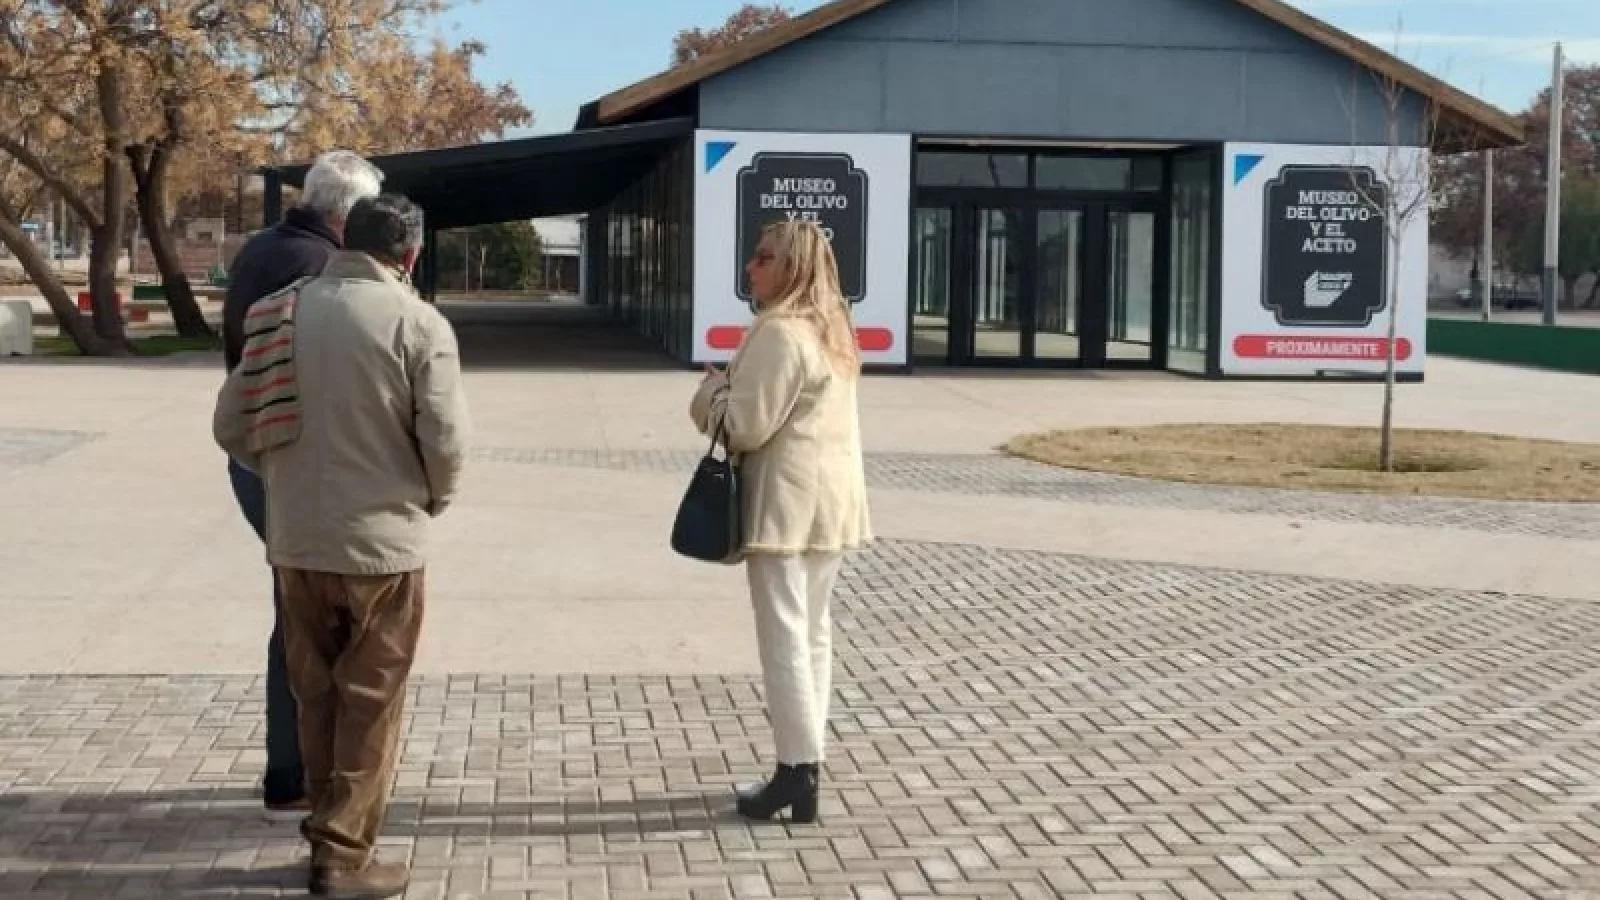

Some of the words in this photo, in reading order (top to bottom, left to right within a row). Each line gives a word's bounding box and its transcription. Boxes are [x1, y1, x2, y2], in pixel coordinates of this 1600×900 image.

[773, 177, 836, 192] MUSEO
[760, 193, 792, 208] DEL
[795, 194, 847, 209] OLIVO
[1299, 190, 1358, 205] MUSEO
[1286, 206, 1317, 219] DEL
[1320, 207, 1370, 221] OLIVO
[1310, 222, 1322, 236] Y
[1325, 223, 1345, 237] EL
[1302, 238, 1357, 253] ACETO
